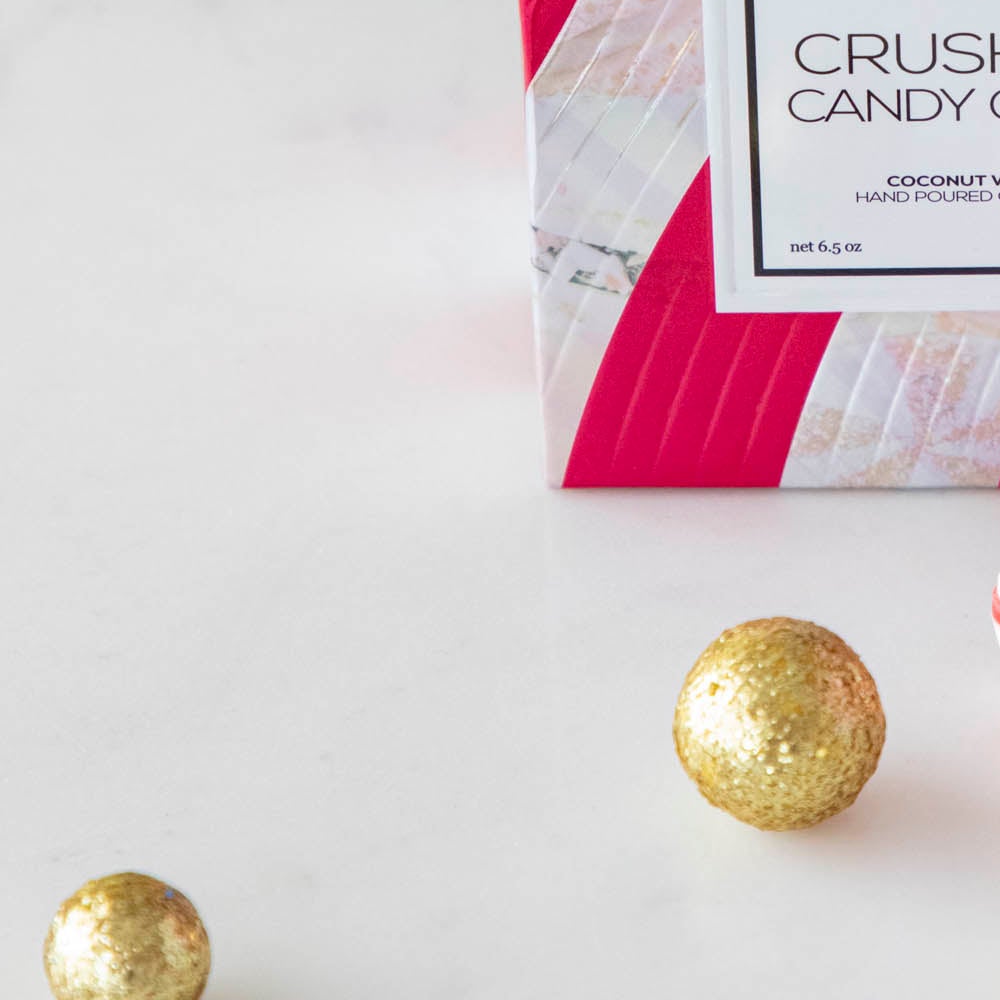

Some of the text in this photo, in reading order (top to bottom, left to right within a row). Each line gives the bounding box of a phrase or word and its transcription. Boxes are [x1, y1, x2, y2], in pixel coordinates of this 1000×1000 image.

[788, 88, 976, 122] CANDY
[887, 174, 987, 187] COCONUT
[856, 191, 910, 203] HAND
[915, 190, 993, 203] POURED
[790, 240, 863, 255] net 6.5 oz
